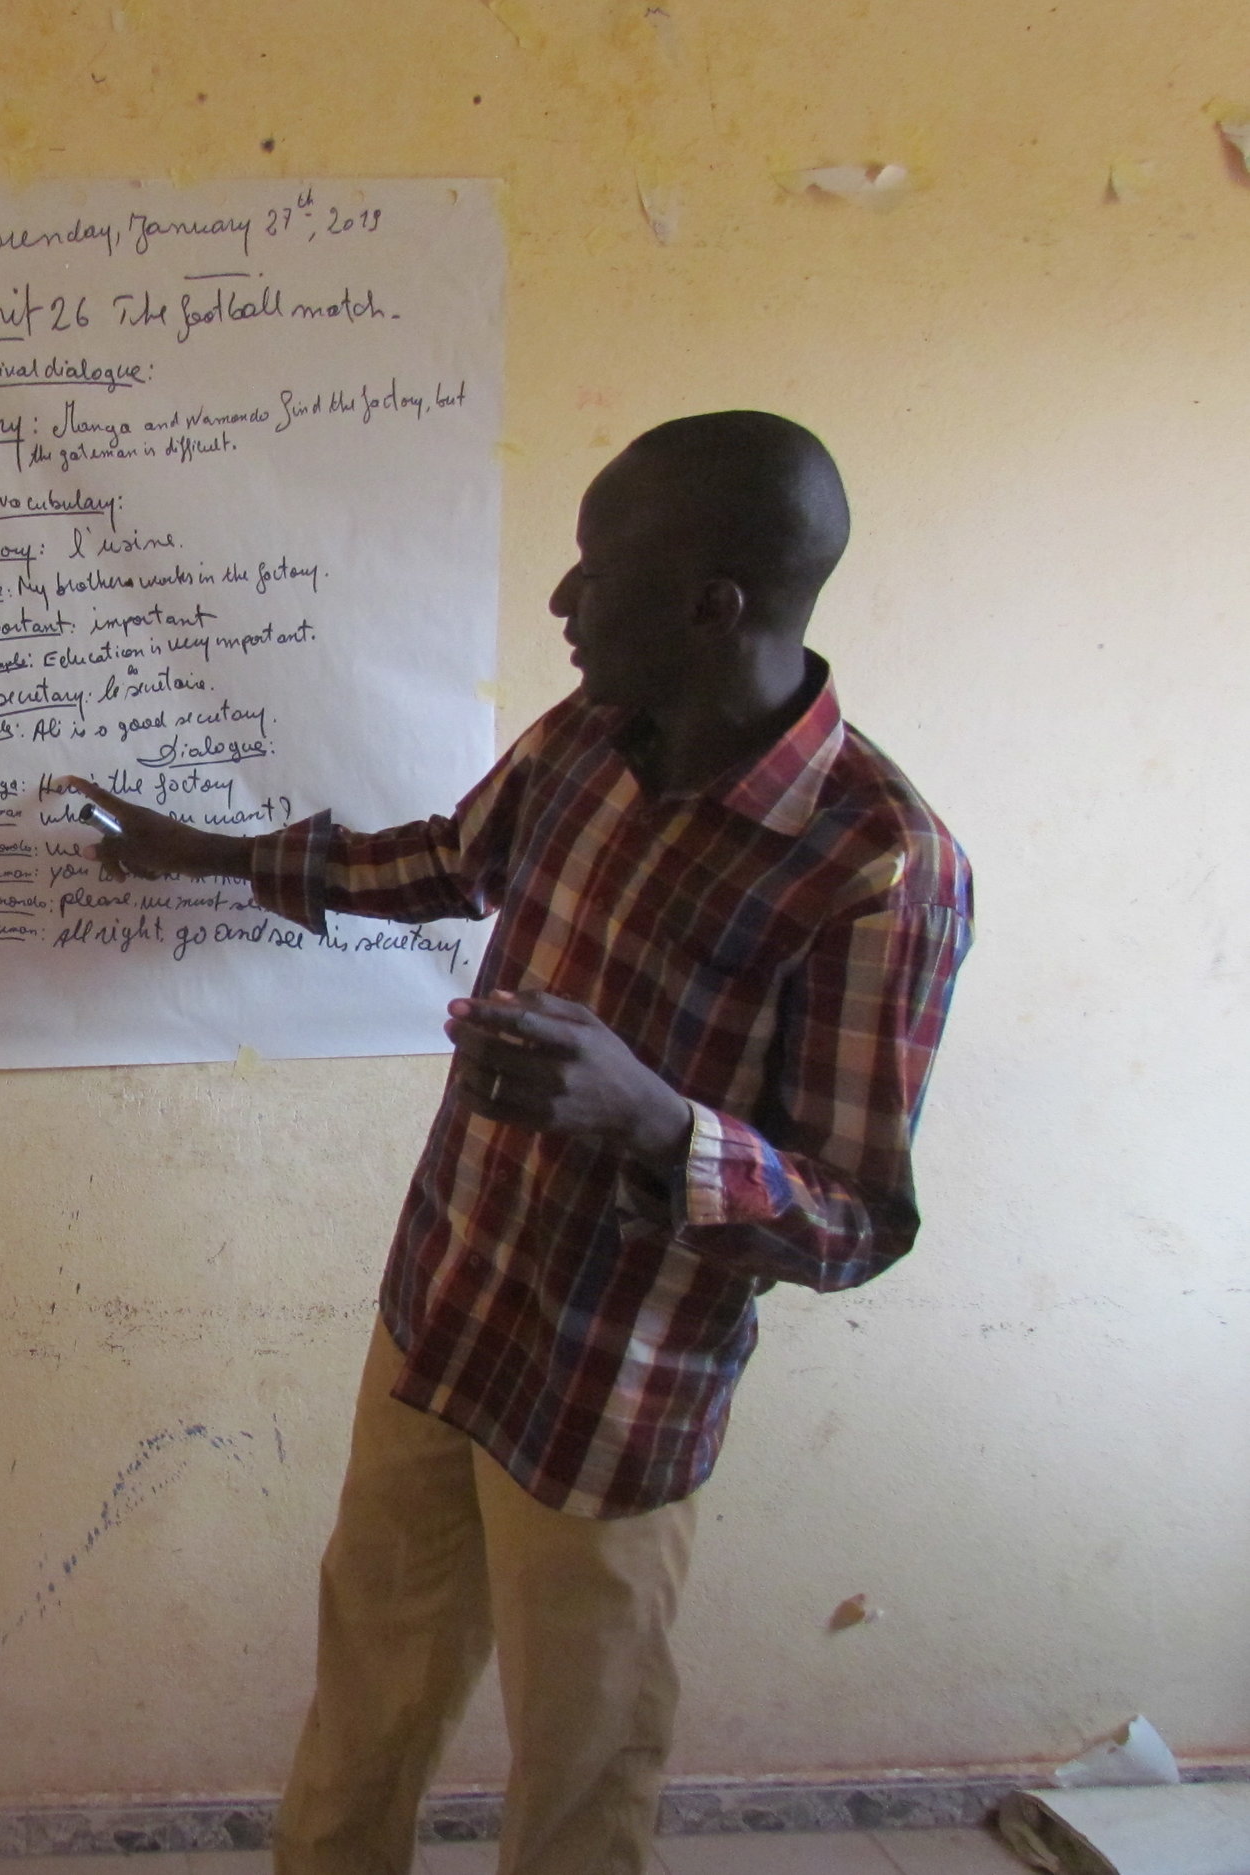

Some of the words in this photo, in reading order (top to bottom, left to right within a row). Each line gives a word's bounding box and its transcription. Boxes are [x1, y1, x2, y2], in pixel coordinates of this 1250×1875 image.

[129, 212, 251, 257] January
[327, 206, 382, 235] 2019
[50, 296, 90, 331] 26
[113, 289, 168, 327] The
[177, 285, 284, 344] football
[144, 410, 179, 433] and
[275, 389, 321, 433] find
[329, 389, 355, 415] the
[436, 379, 466, 409] but
[29, 443, 52, 468] the
[198, 561, 215, 584] in
[222, 562, 250, 583] the
[90, 603, 218, 638] important
[117, 710, 167, 742] good
[108, 768, 143, 794] the
[154, 768, 234, 809] factory
[49, 864, 89, 889] you
[173, 926, 208, 961] go
[214, 918, 269, 944] and
[269, 928, 305, 950] see
